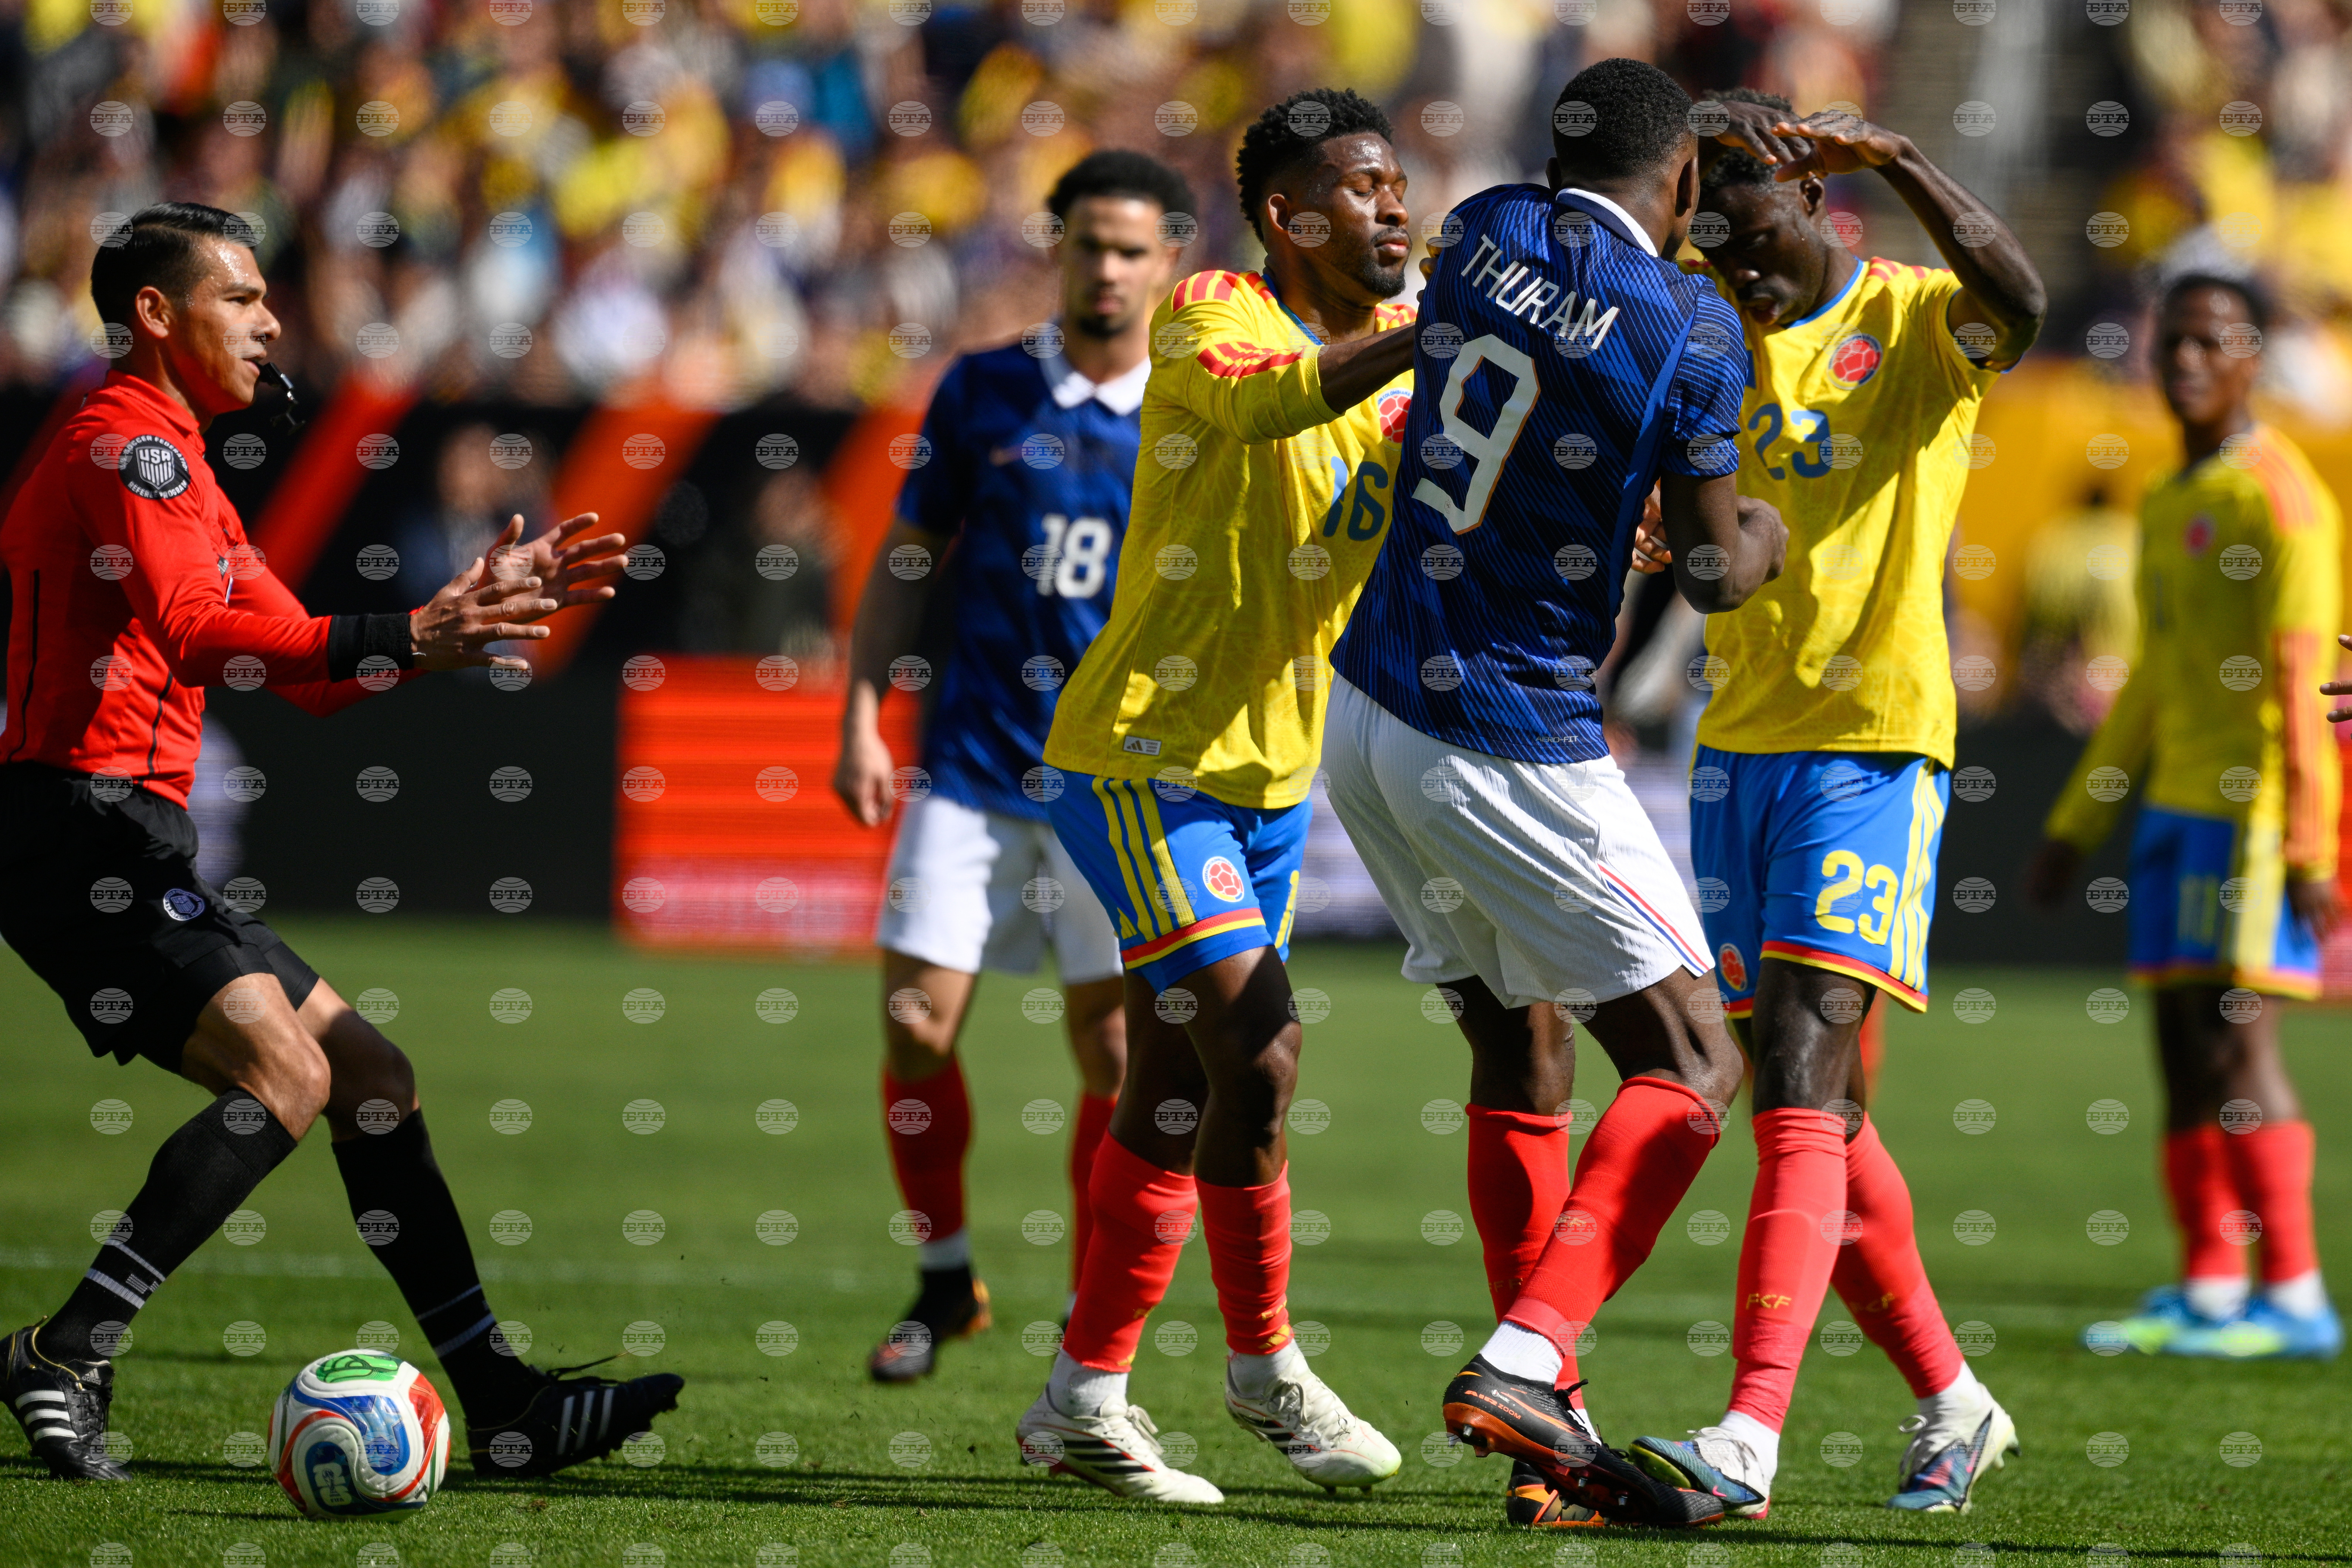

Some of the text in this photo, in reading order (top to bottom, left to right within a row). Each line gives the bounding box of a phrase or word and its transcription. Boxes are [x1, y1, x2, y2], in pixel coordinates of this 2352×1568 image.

[1460, 234, 1620, 350] THURAM
[123, 434, 153, 454] SOCCER
[139, 449, 171, 464] USA
[1411, 333, 1541, 535] 9
[1748, 403, 1833, 481] 23
[1323, 455, 1388, 541] 16
[1036, 514, 1112, 598] 18
[1815, 850, 1899, 945] 23
[1746, 1293, 1792, 1310] FCF
[82, 1376, 102, 1385] adidas
[1465, 1390, 1498, 1406] AIR
[1498, 1403, 1521, 1420] ZOOM
